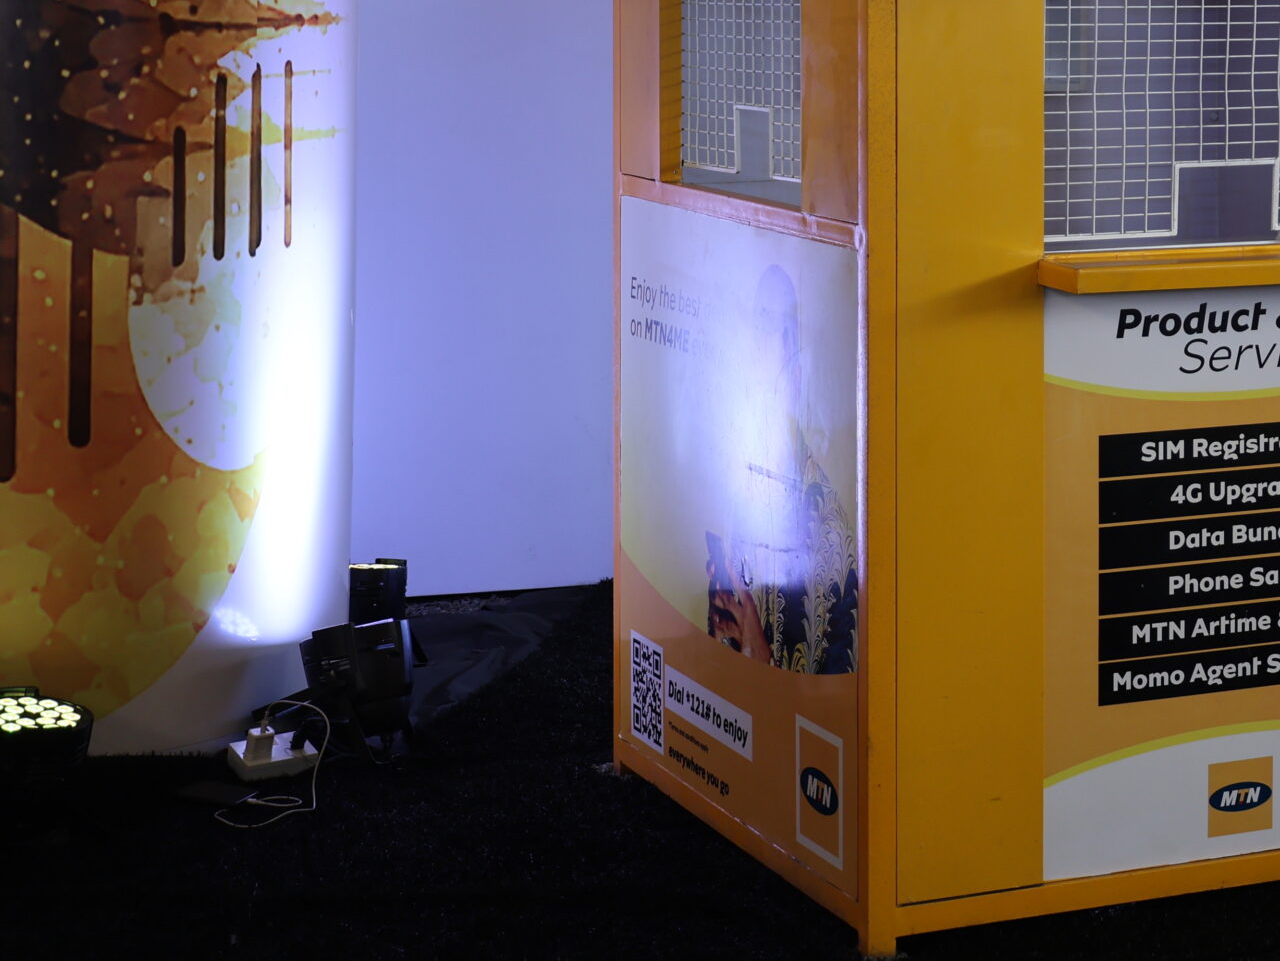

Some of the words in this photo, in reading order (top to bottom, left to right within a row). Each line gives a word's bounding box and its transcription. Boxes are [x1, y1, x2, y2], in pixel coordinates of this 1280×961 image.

[630, 276, 658, 311] Enjoy
[659, 283, 676, 311] the
[630, 318, 643, 338] on
[644, 317, 690, 354] MTN4ME
[1116, 301, 1267, 339] Product
[1140, 440, 1185, 462] SIM
[1170, 483, 1202, 505] 4G
[1169, 527, 1225, 550] Data
[1168, 573, 1243, 596] Phone
[1132, 620, 1185, 644] MTN
[1191, 612, 1271, 638] Artime
[1112, 669, 1185, 692] Momo
[1190, 657, 1262, 686] Agent
[668, 679, 685, 706] Dial
[712, 707, 722, 729] to
[723, 718, 748, 749] enjoy
[668, 746, 706, 780] everywhere
[706, 770, 719, 788] you
[719, 780, 730, 797] go
[806, 774, 832, 808] MTN
[1220, 786, 1261, 808] MTN
